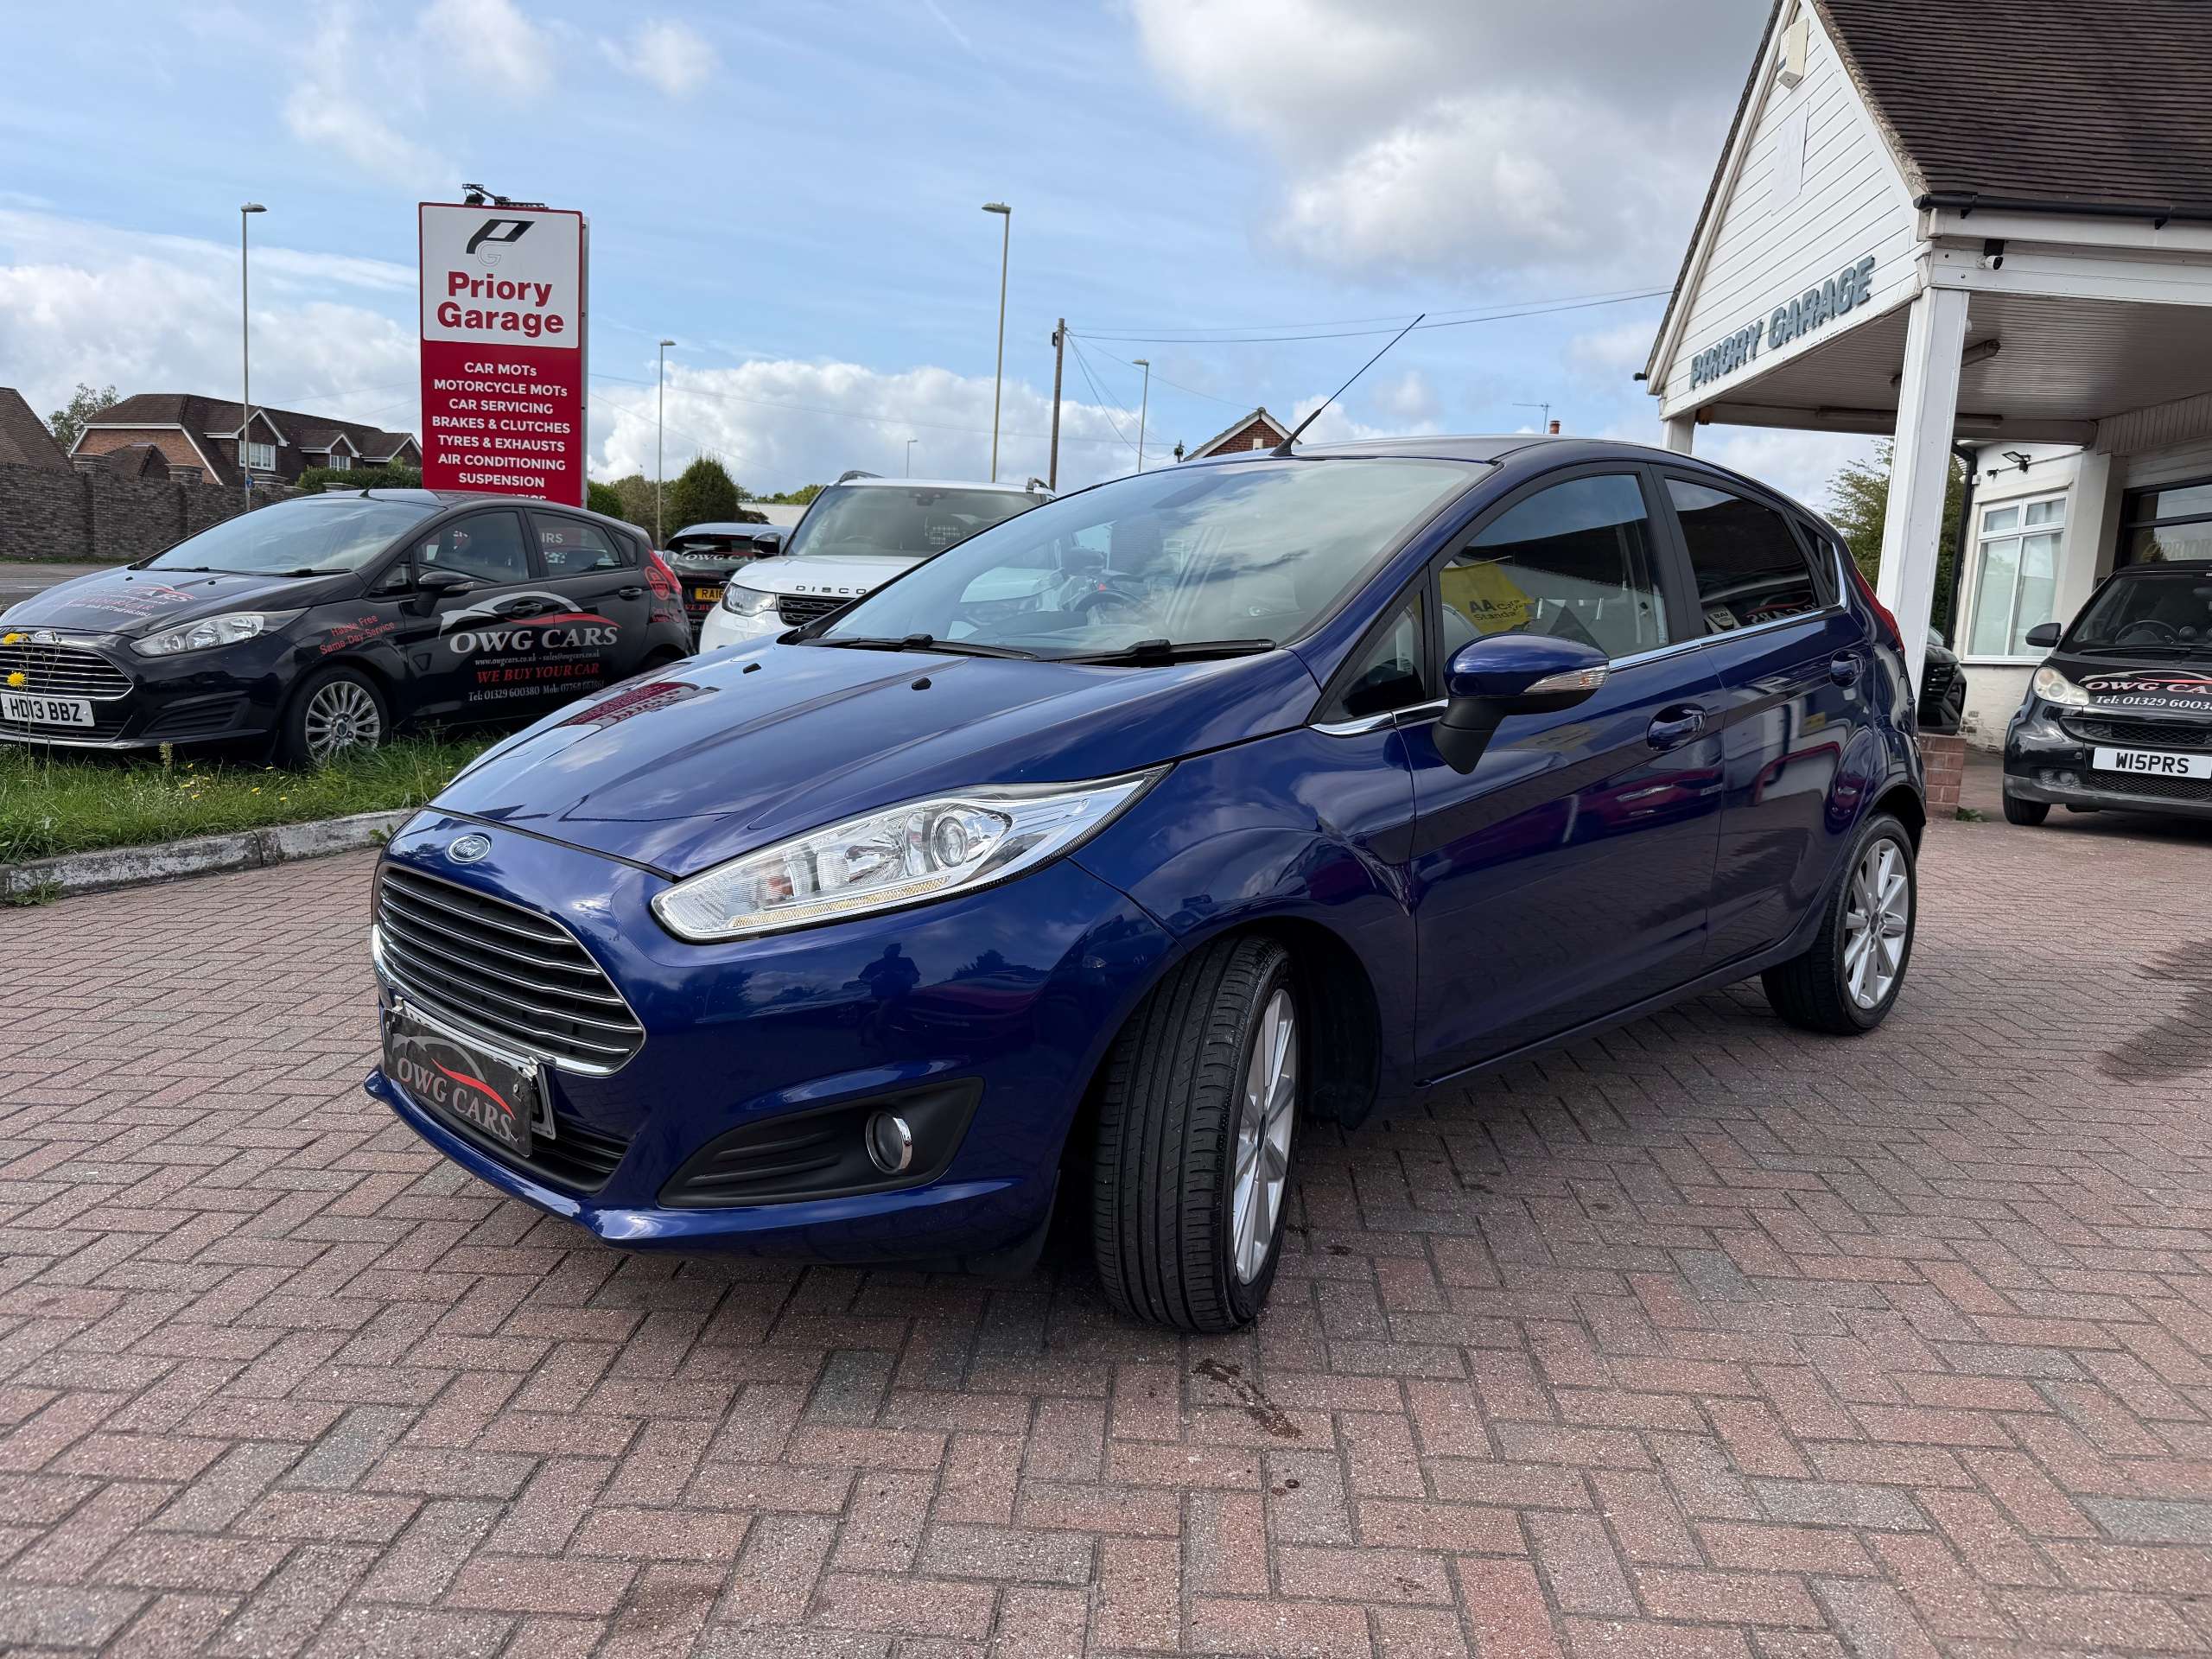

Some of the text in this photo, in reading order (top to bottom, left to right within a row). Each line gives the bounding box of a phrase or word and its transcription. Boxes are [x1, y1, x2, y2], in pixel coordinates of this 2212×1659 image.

[448, 270, 553, 307] Priory
[436, 302, 564, 338] Garage
[1689, 254, 1875, 390] PRIORY GARAGE
[464, 362, 537, 377] CAR MOTs
[434, 378, 568, 397] MOTORCYCLE MOTs
[449, 398, 554, 415] CAR SERVICING
[432, 416, 570, 434] BRAKES & CLUTCHES
[438, 435, 565, 452] TYRES & EXHAUSTS
[438, 454, 566, 471] AIR CONDITIONING
[458, 473, 545, 487] SUSPENSION
[1469, 599, 1497, 613] AA
[358, 615, 378, 626] Free
[319, 639, 346, 655] Same
[365, 622, 395, 638] Service
[449, 626, 618, 653] OWG CARS
[477, 663, 600, 683] WE BUY YOUR CAR
[468, 691, 483, 702] Tel:
[485, 688, 508, 700] 01329
[509, 685, 540, 697] 600380
[2085, 681, 2160, 691] OWG
[9, 697, 83, 722] HD13 BBZ
[2095, 695, 2212, 710] Tel: 01329 6003
[397, 1056, 513, 1141] OWG CARS
